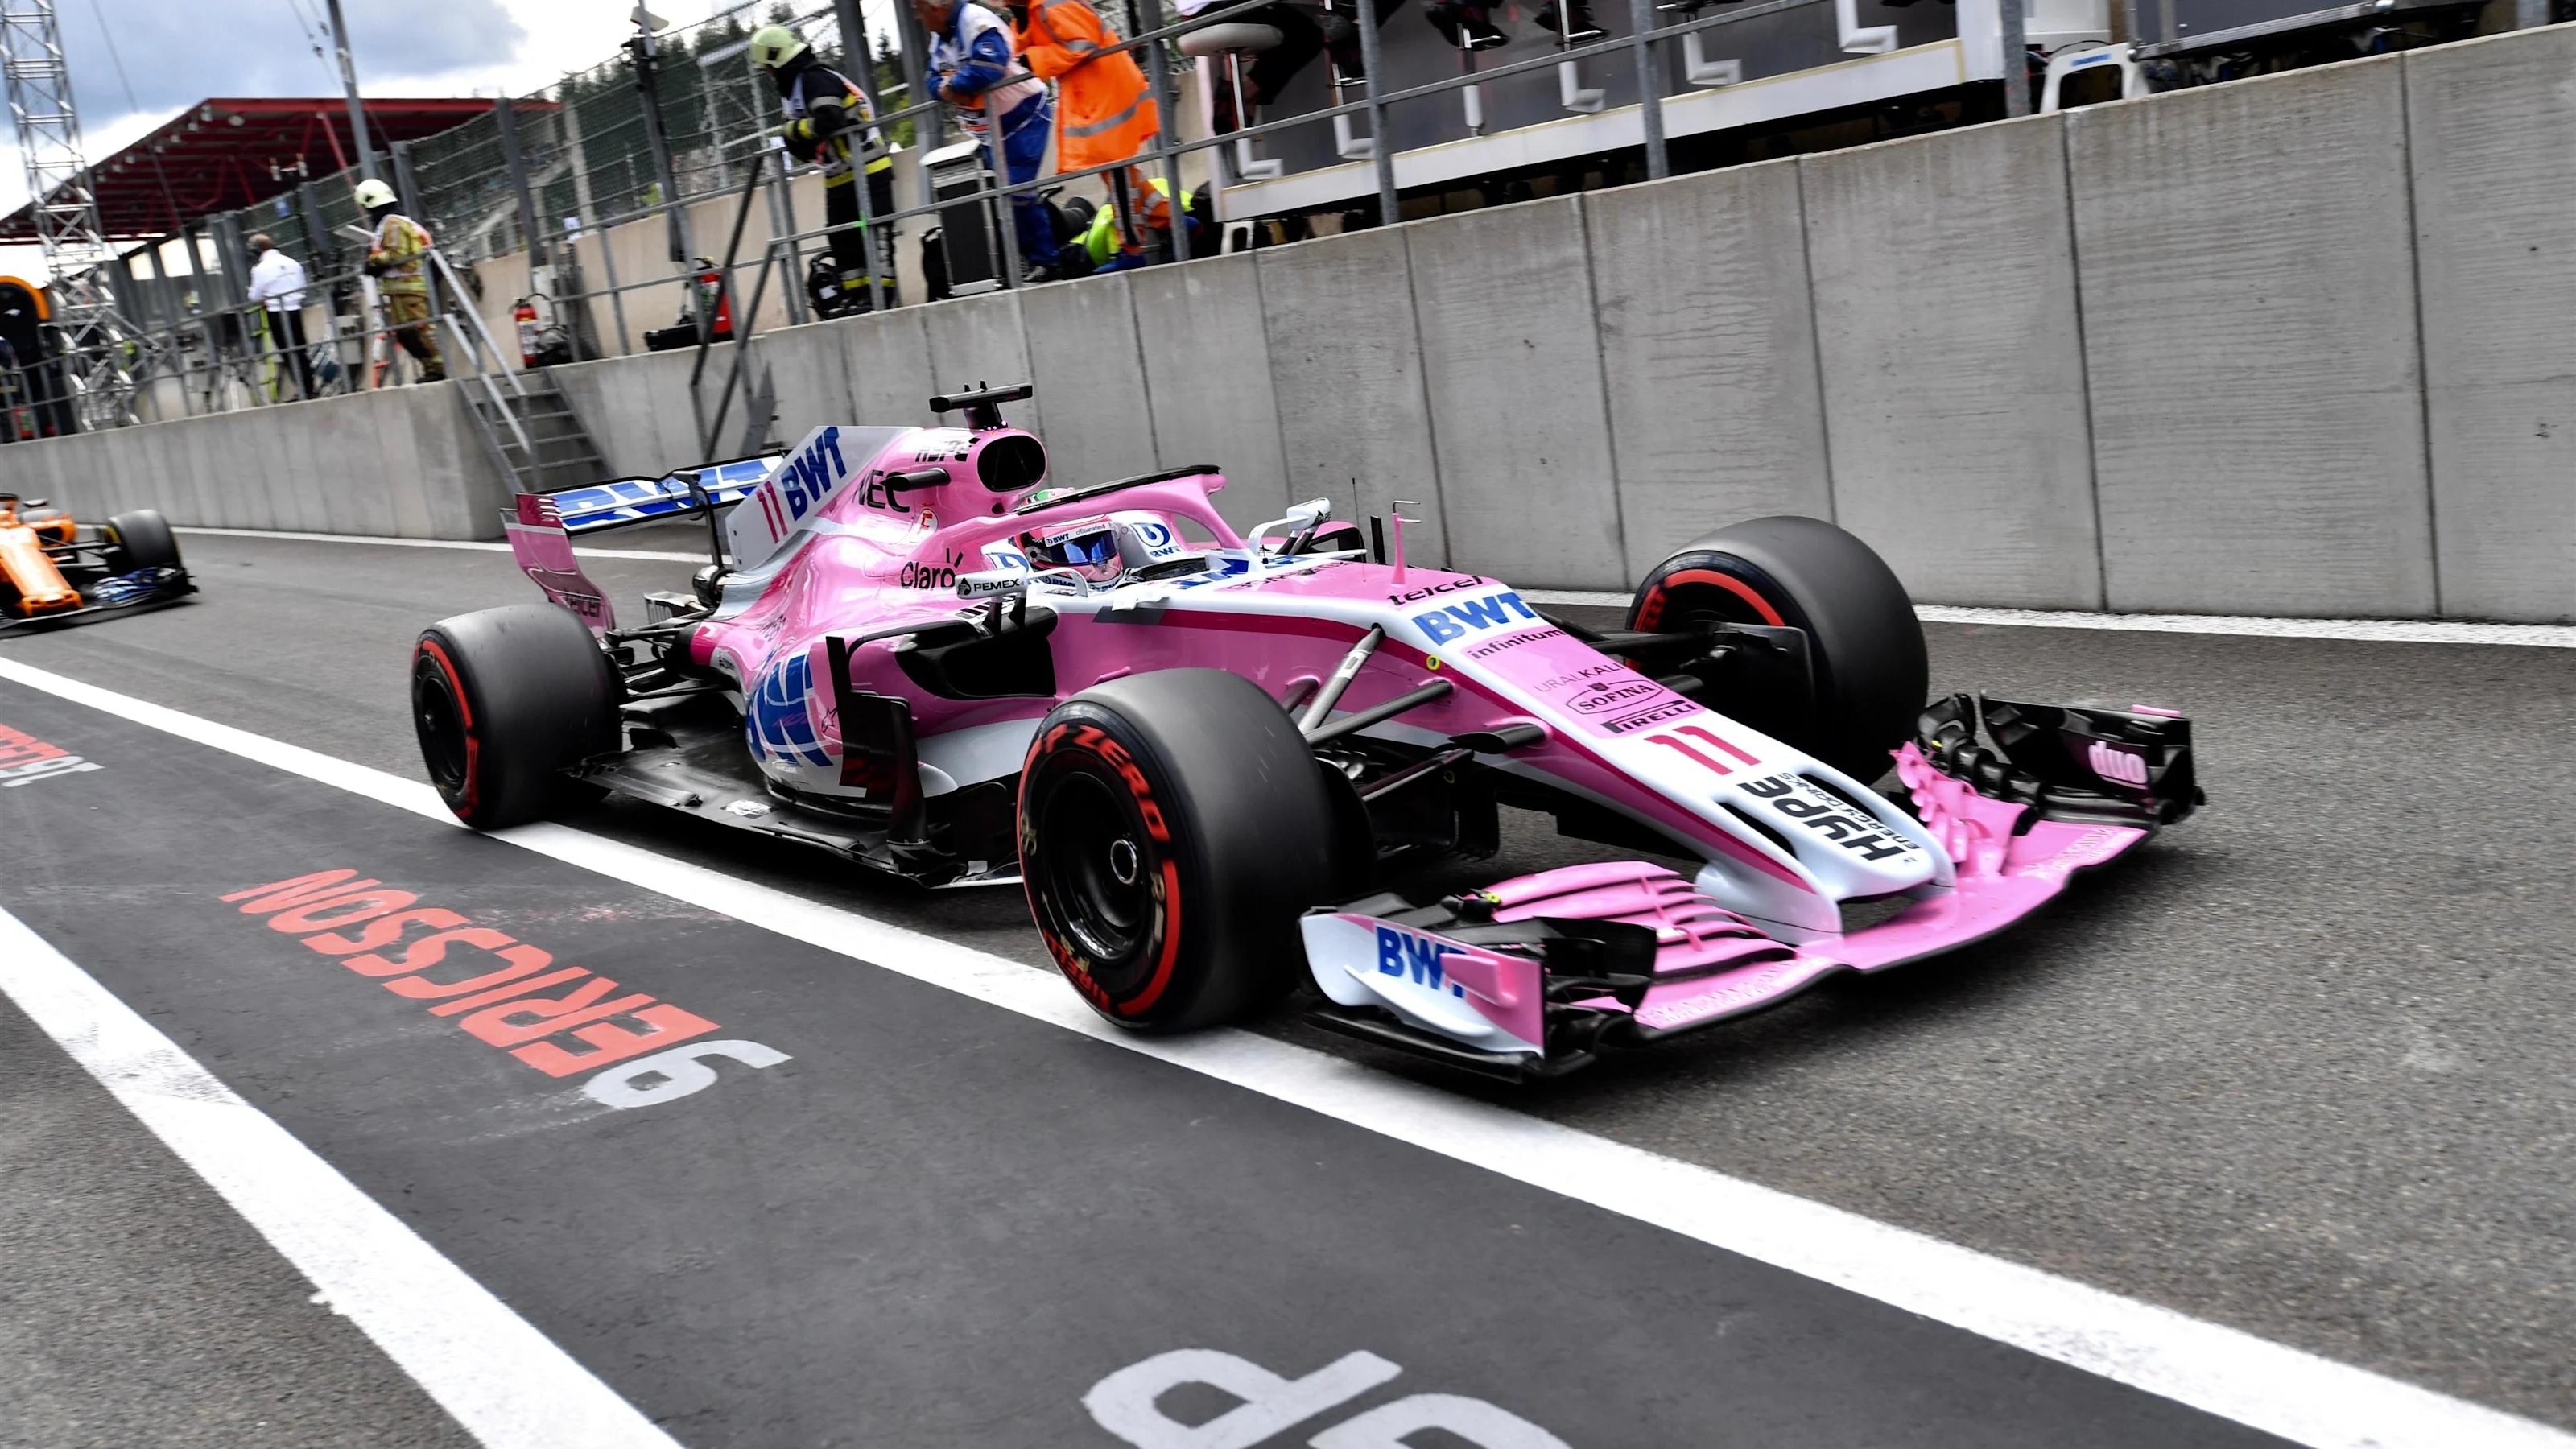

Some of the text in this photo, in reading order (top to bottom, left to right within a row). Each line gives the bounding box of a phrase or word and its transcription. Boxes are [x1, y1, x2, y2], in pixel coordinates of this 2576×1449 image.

[780, 419, 847, 522] BWT
[852, 469, 910, 513] NEC
[756, 481, 789, 544] 11
[1053, 533, 1070, 544] BWT
[1149, 545, 1183, 558] BWT
[901, 554, 959, 590] Claro
[973, 578, 1020, 592] PEMEX
[1386, 575, 1484, 605] telcel
[1411, 592, 1538, 646] BWT
[1468, 627, 1567, 659] infinitum
[1533, 663, 1626, 692] URALKALI
[1579, 683, 1655, 711] SOFINA
[1600, 699, 1698, 734] PIRELLI
[1642, 724, 1762, 776] 11
[1071, 724, 1172, 843] ZERO
[1777, 772, 1843, 807] DRINKS
[1736, 775, 1908, 861] HYPE
[218, 869, 793, 1110] 9 ERICSSON
